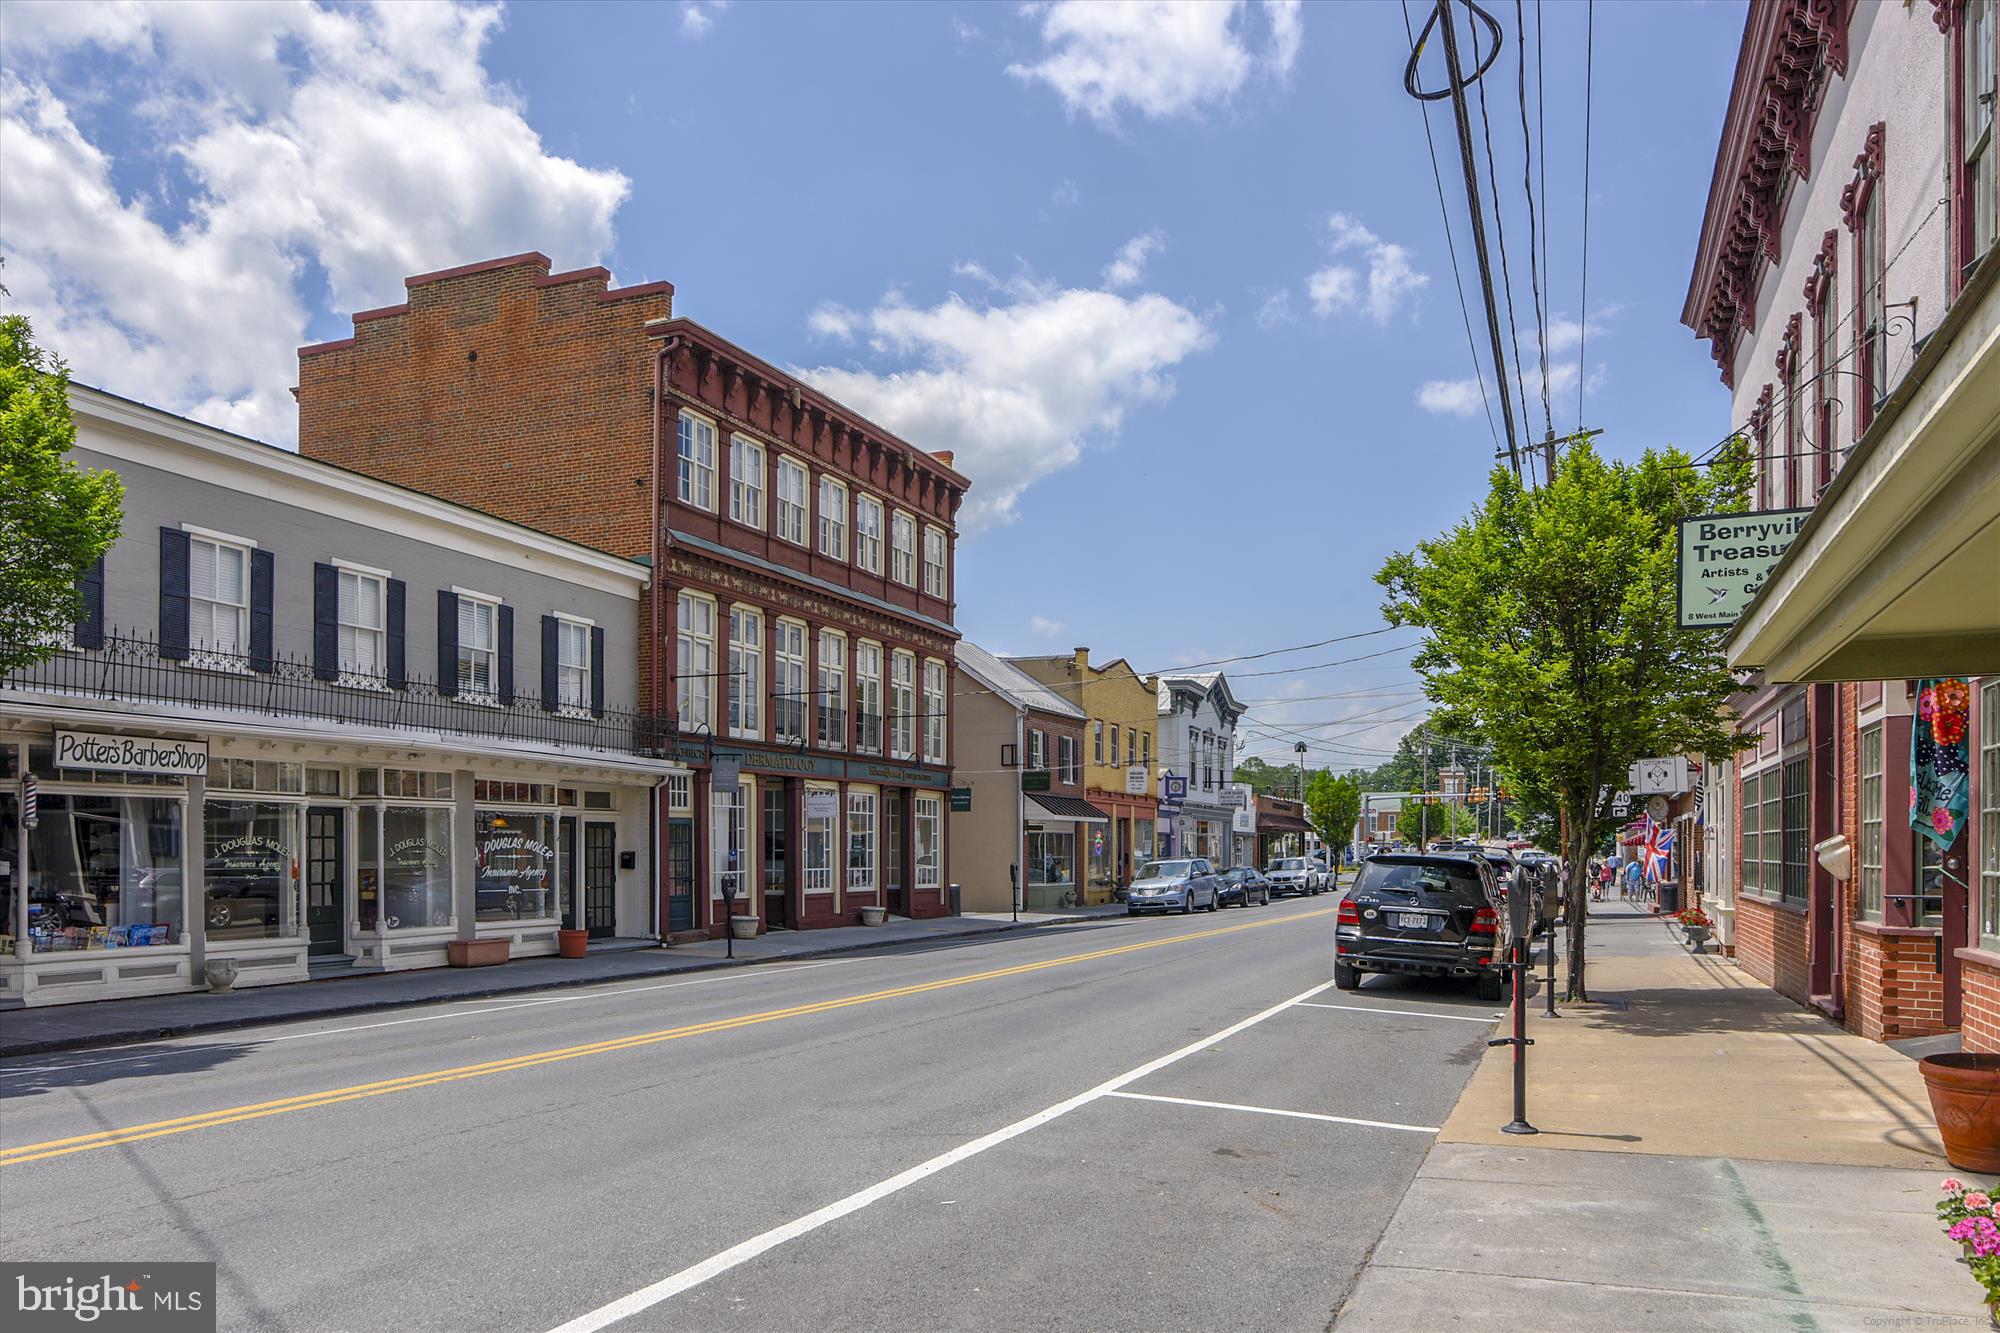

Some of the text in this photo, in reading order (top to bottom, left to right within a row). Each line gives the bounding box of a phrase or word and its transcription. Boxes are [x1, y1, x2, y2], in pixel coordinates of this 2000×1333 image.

[1701, 567, 1763, 581] Artists &
[1695, 612, 1717, 620] West
[1719, 611, 1739, 619] Main
[58, 734, 120, 765] Potter's
[745, 752, 816, 772] DERMATOLOGY
[221, 837, 263, 853] DOUGLAS
[265, 838, 291, 860] MOLER
[394, 838, 424, 852] DOUGLAS
[474, 837, 554, 860] J. DOUGLAS MOLER
[481, 865, 547, 881] Insurance Agency
[508, 885, 522, 895] INC.
